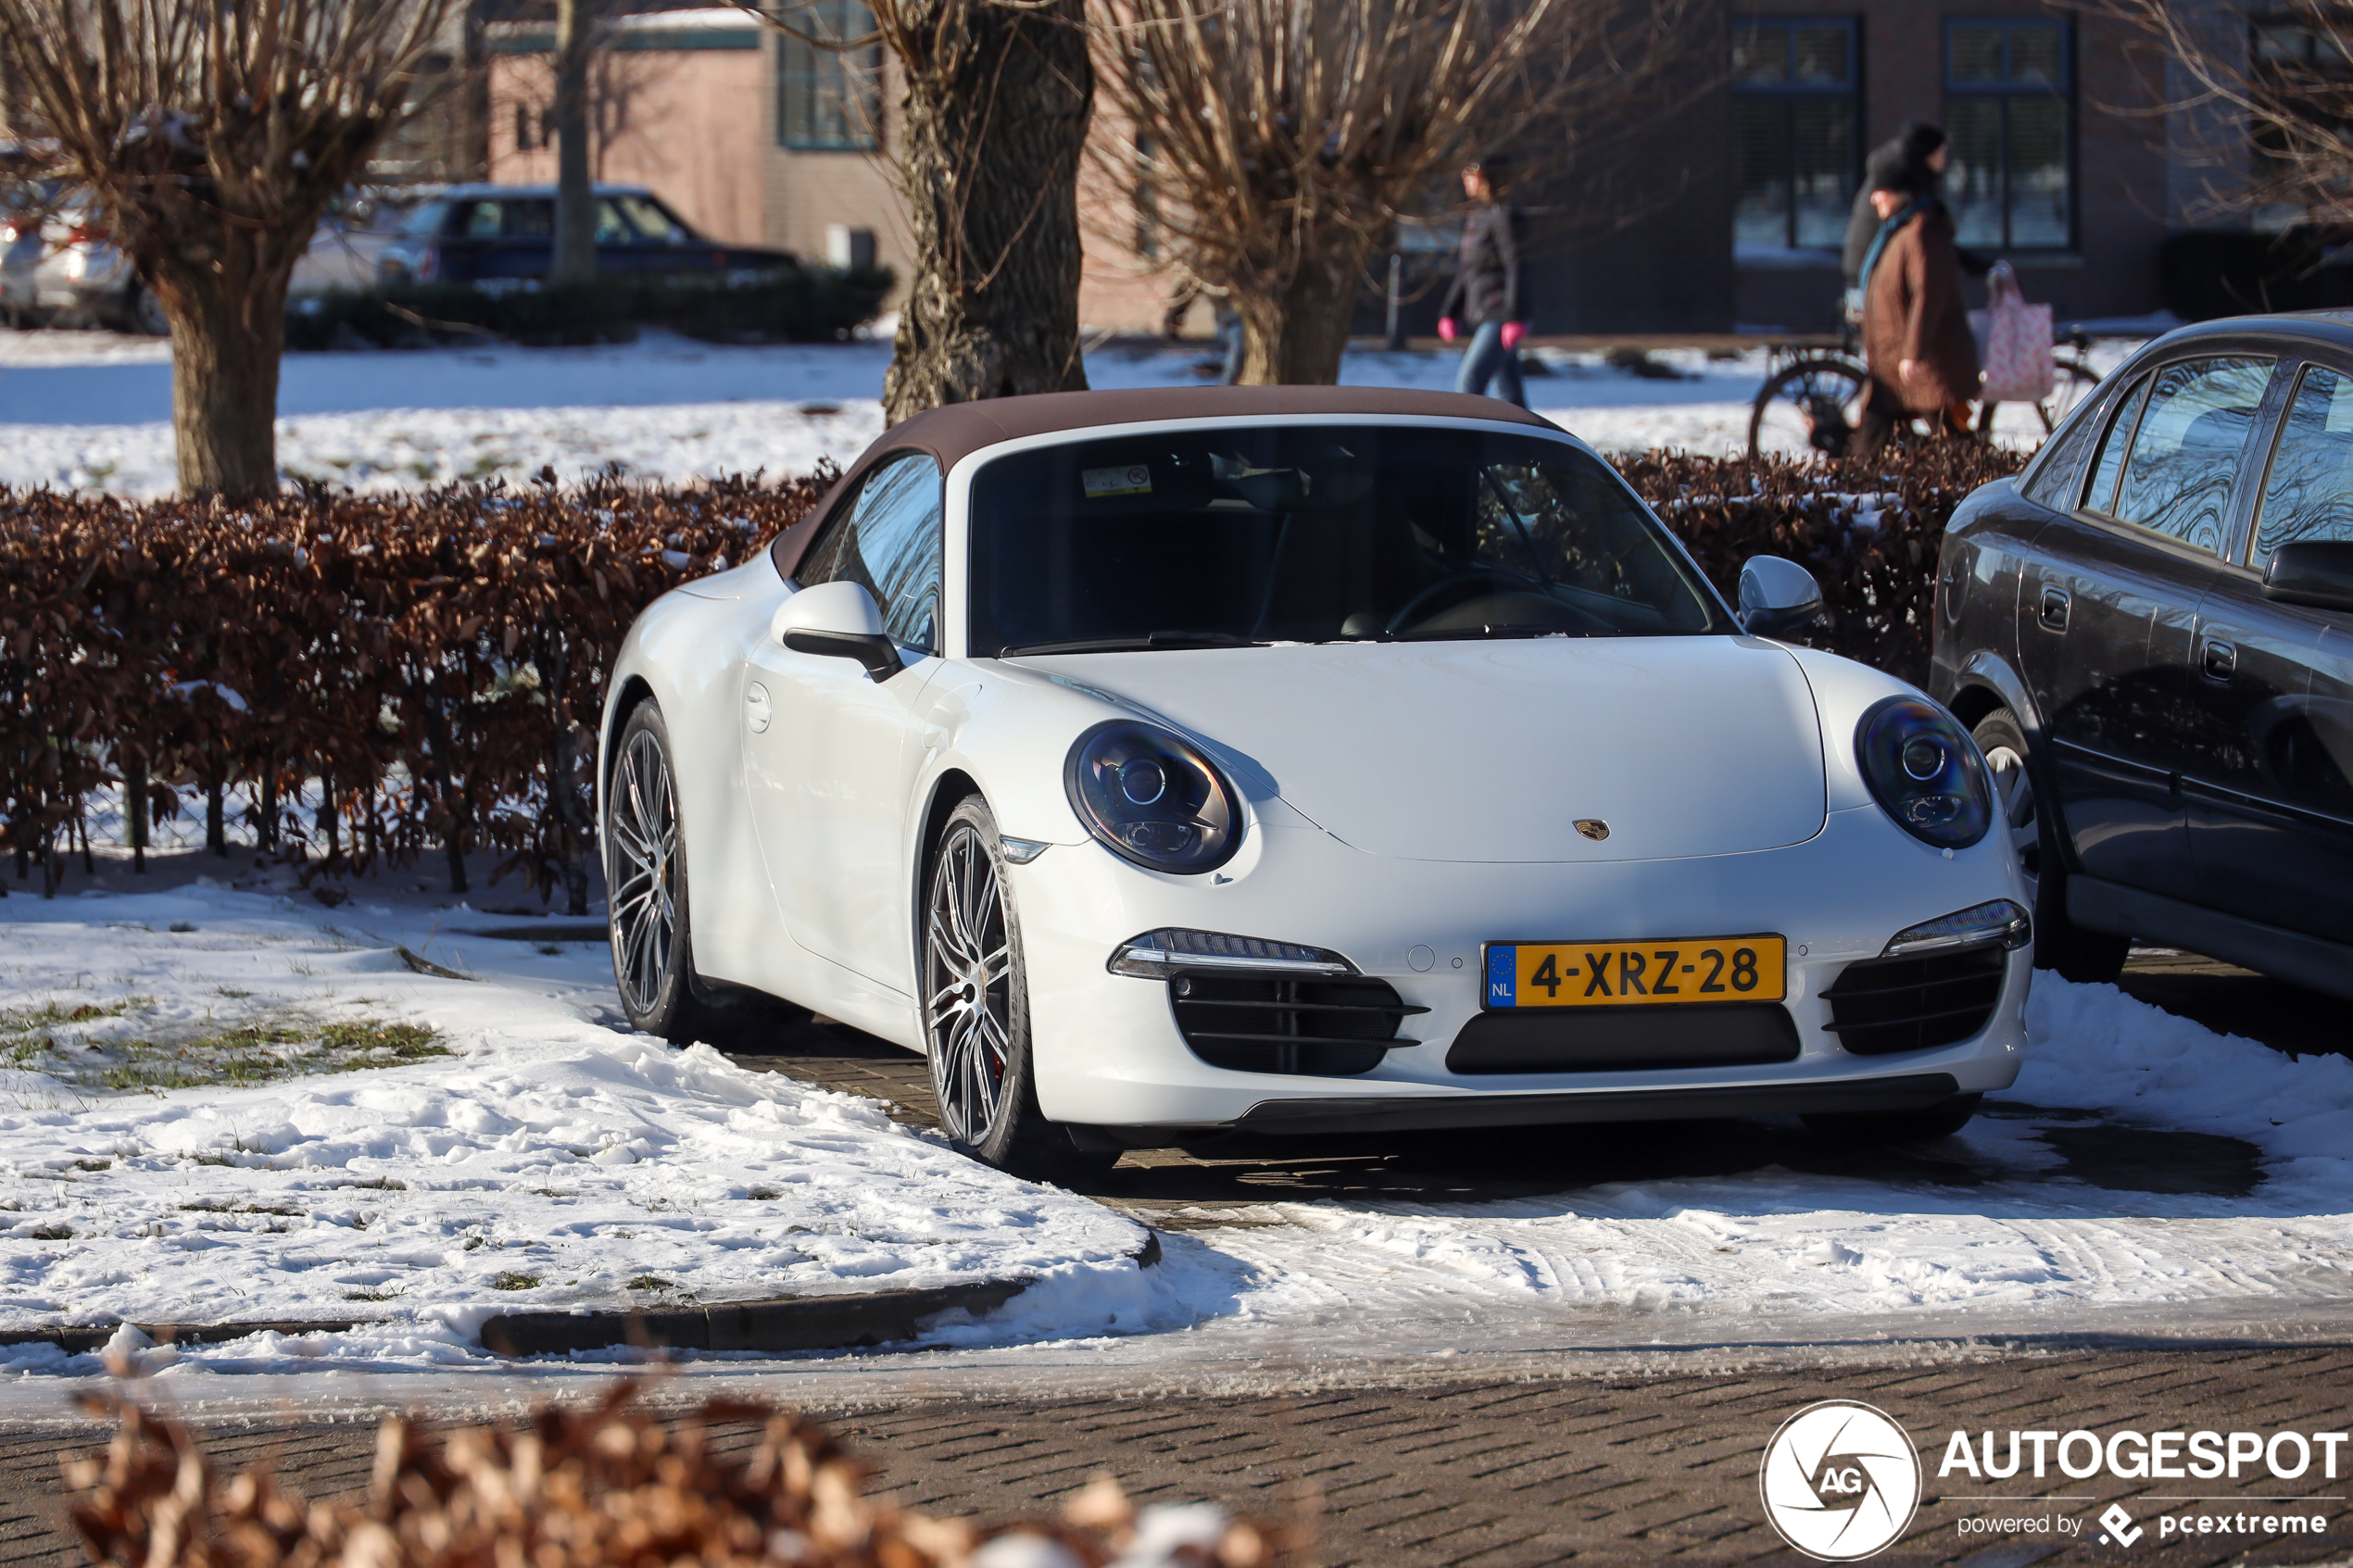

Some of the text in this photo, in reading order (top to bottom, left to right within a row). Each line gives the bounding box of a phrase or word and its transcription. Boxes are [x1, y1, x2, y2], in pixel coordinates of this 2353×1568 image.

[989, 843, 1012, 912] 245/35
[1492, 983, 1512, 997] NL
[1530, 947, 1759, 997] 4-XRZ-28
